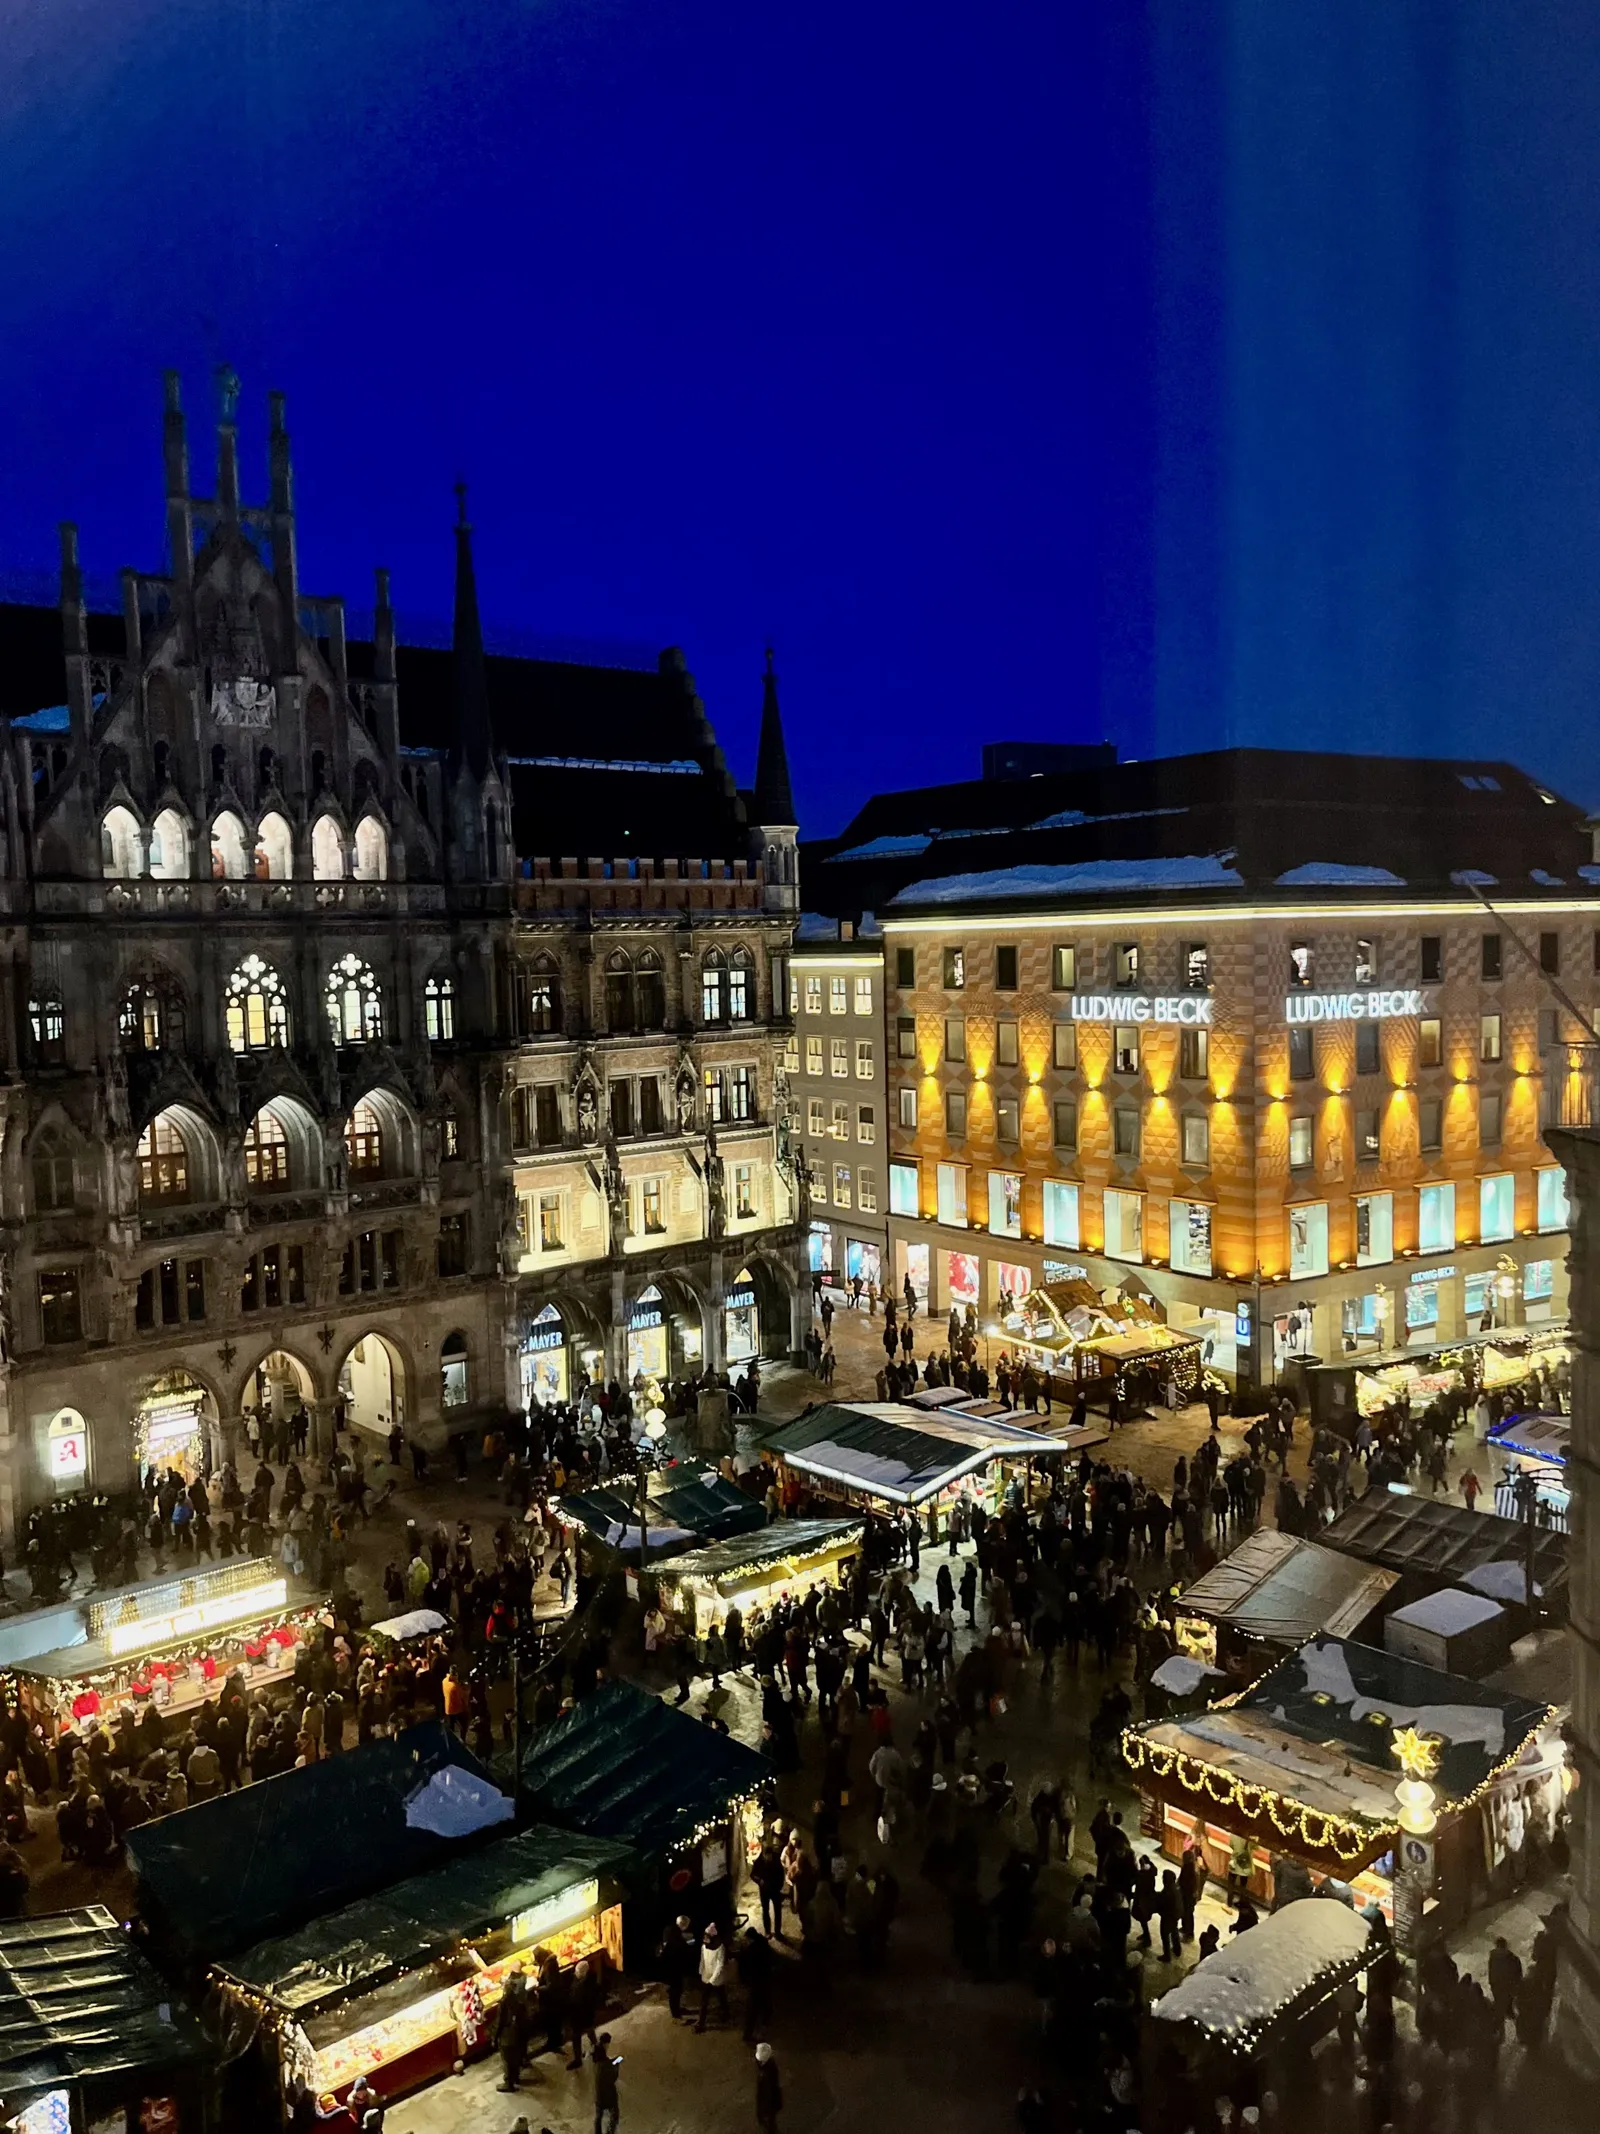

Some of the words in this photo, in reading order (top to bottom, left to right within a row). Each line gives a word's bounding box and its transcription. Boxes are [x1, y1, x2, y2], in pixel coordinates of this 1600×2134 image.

[1071, 996, 1151, 1022] LUDWIG
[1154, 997, 1211, 1023] BECK
[1286, 993, 1365, 1023] LUDWIG
[1368, 990, 1419, 1018] BECK
[726, 1291, 755, 1310] MAYER
[1237, 1302, 1249, 1318] S
[631, 1311, 662, 1330] MAYER
[1237, 1319, 1248, 1335] U
[529, 1331, 563, 1351] MAYER
